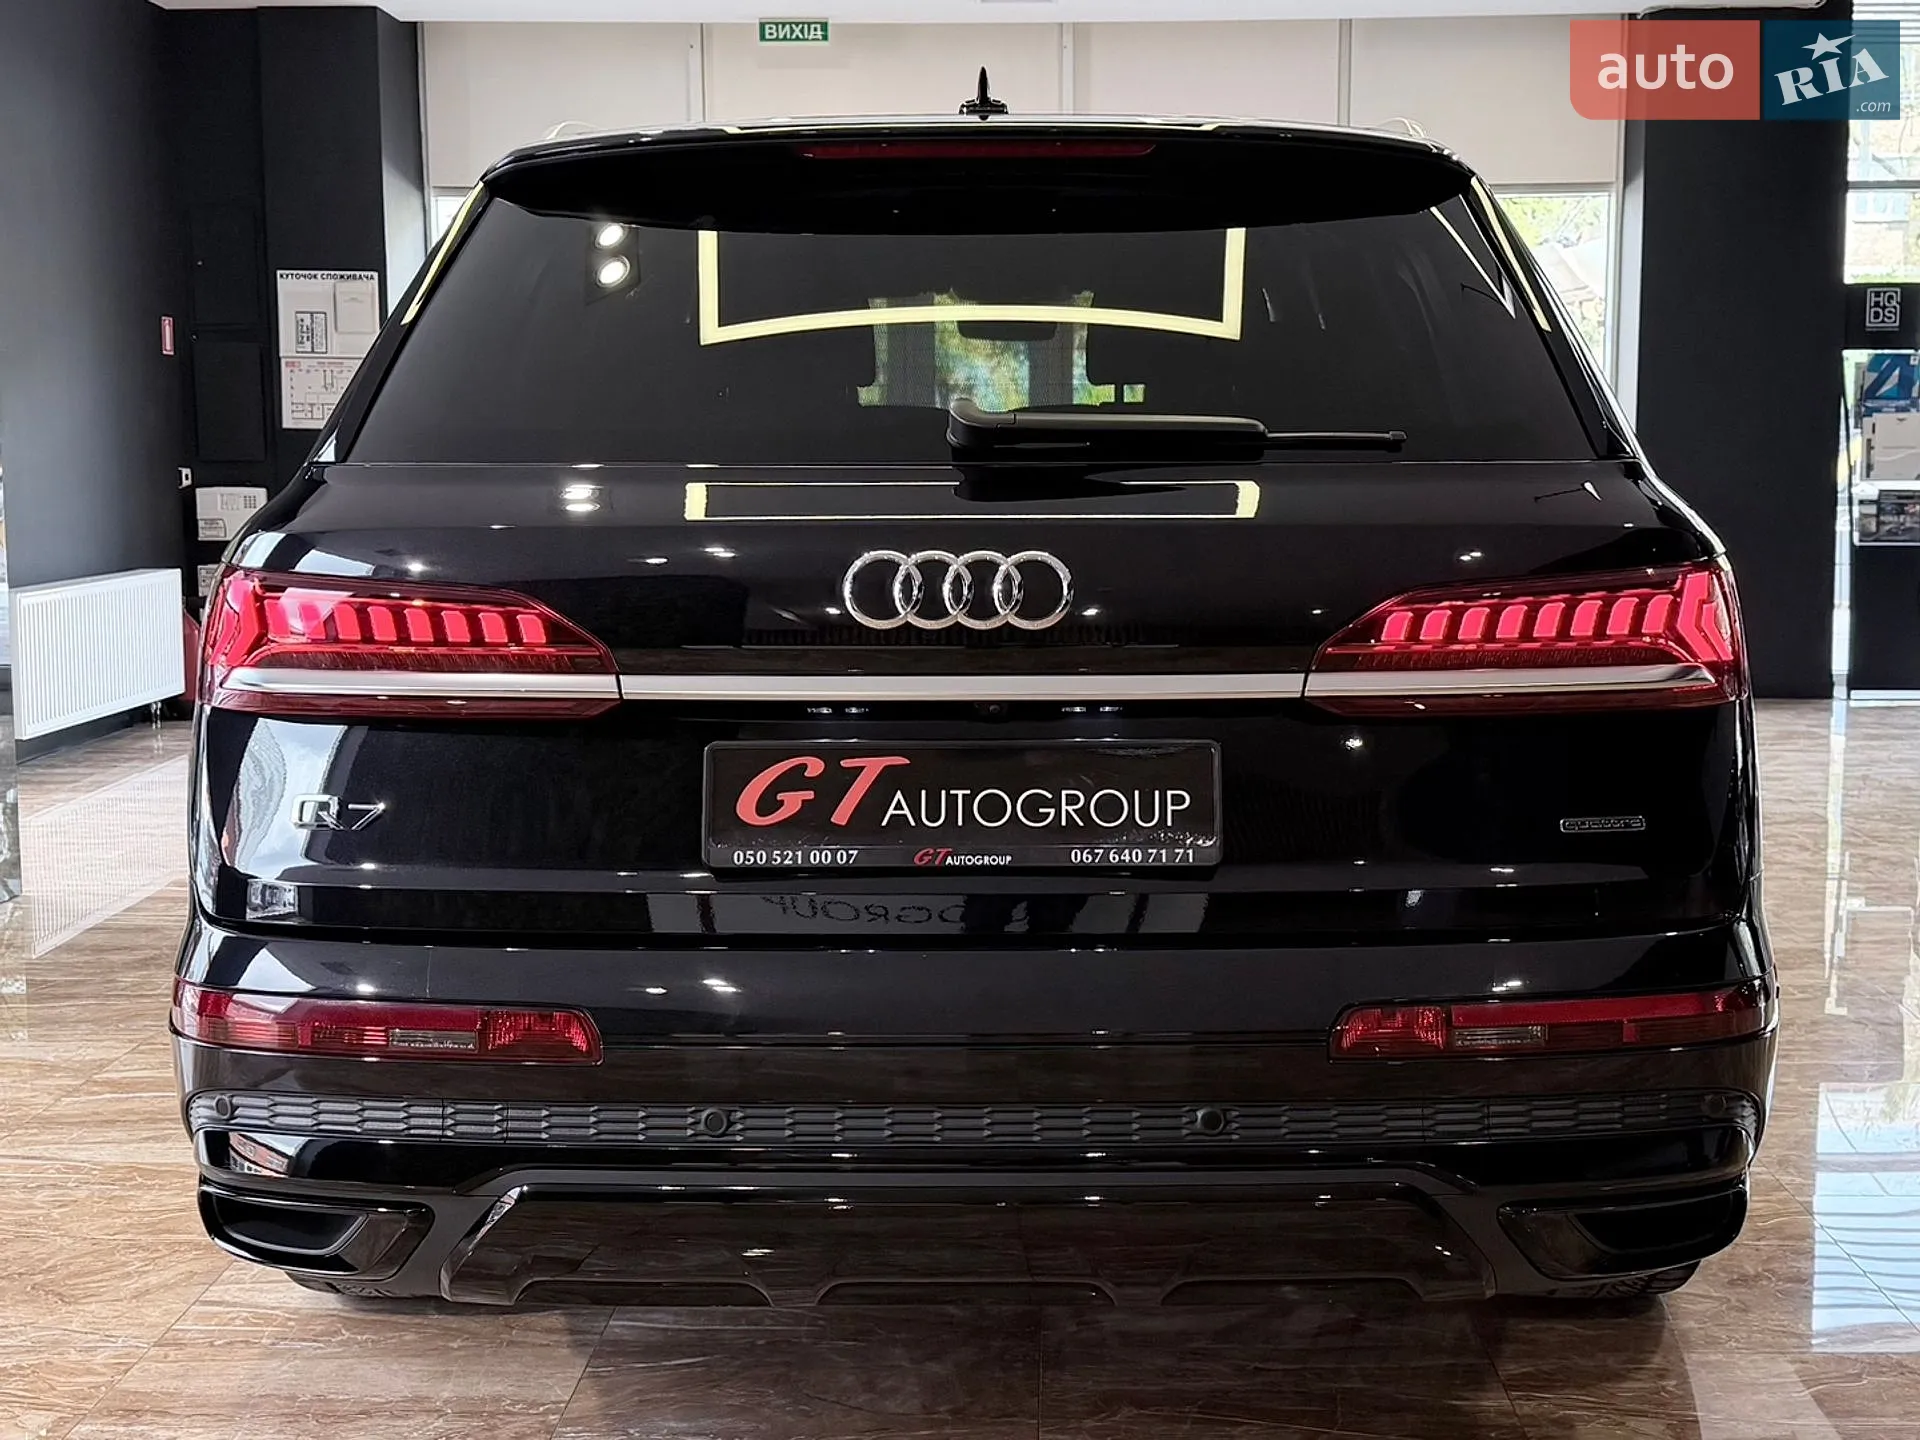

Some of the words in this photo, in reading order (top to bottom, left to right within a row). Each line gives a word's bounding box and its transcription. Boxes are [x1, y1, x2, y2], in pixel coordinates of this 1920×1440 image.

[765, 24, 825, 40] ВИХІД
[280, 272, 318, 280] КУТОЧОК
[320, 272, 375, 281] СПОЖИВАЧА
[1870, 307, 1896, 323] DS
[736, 756, 911, 826] GT
[881, 788, 1191, 828] AUTOGROUP
[292, 794, 385, 830] Q7
[733, 850, 767, 865] 050
[771, 850, 803, 865] 521
[809, 850, 826, 865] 00
[836, 850, 858, 865] 07
[913, 848, 953, 866] GT
[945, 855, 1012, 866] AUTOGROUP
[1071, 848, 1103, 864] 067
[1109, 848, 1142, 864] 640
[1148, 848, 1168, 863] 71
[1174, 848, 1194, 863] 71
